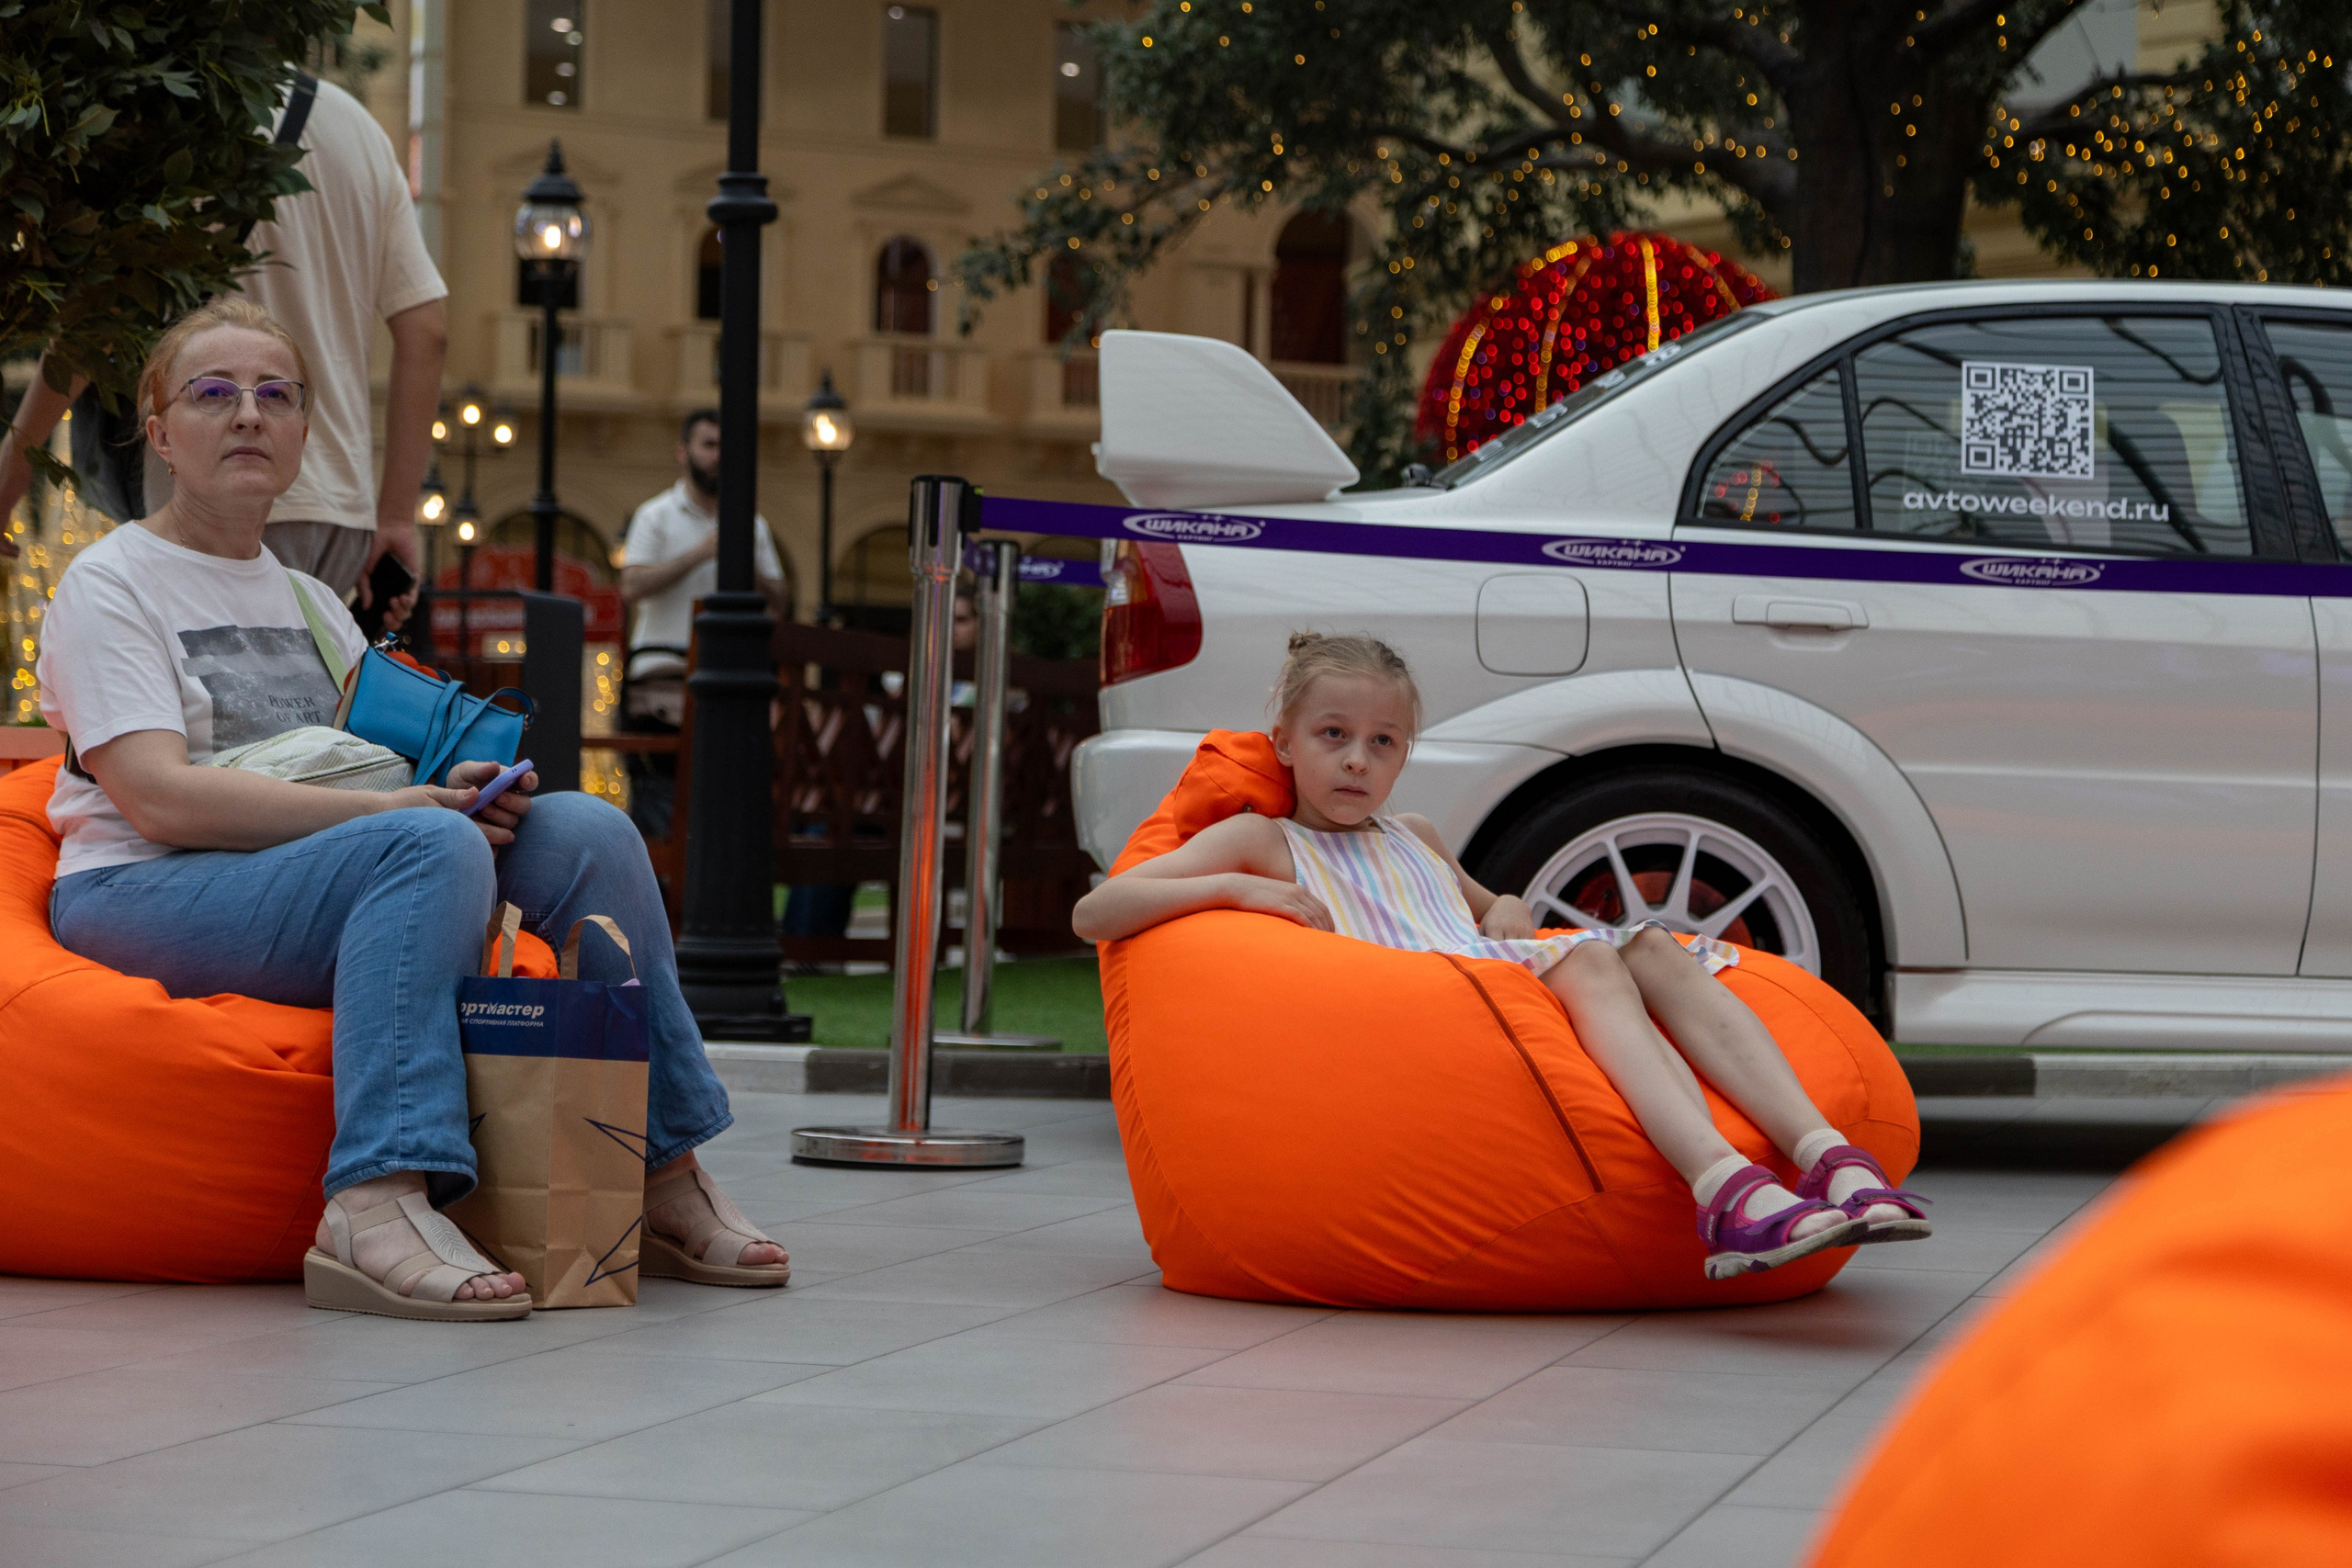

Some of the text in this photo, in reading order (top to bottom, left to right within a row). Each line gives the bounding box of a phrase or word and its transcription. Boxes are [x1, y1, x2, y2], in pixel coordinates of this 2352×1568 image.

[1904, 490, 2169, 522] avtoweekend.ru
[1144, 518, 1249, 537] ШИКАНА
[1564, 544, 1668, 562] ШИКАНА
[1982, 562, 2087, 581] ШИКАНА
[267, 694, 316, 709] POWER
[276, 710, 321, 724] OF ART
[469, 1018, 506, 1026] СПОРТИВНАЯ
